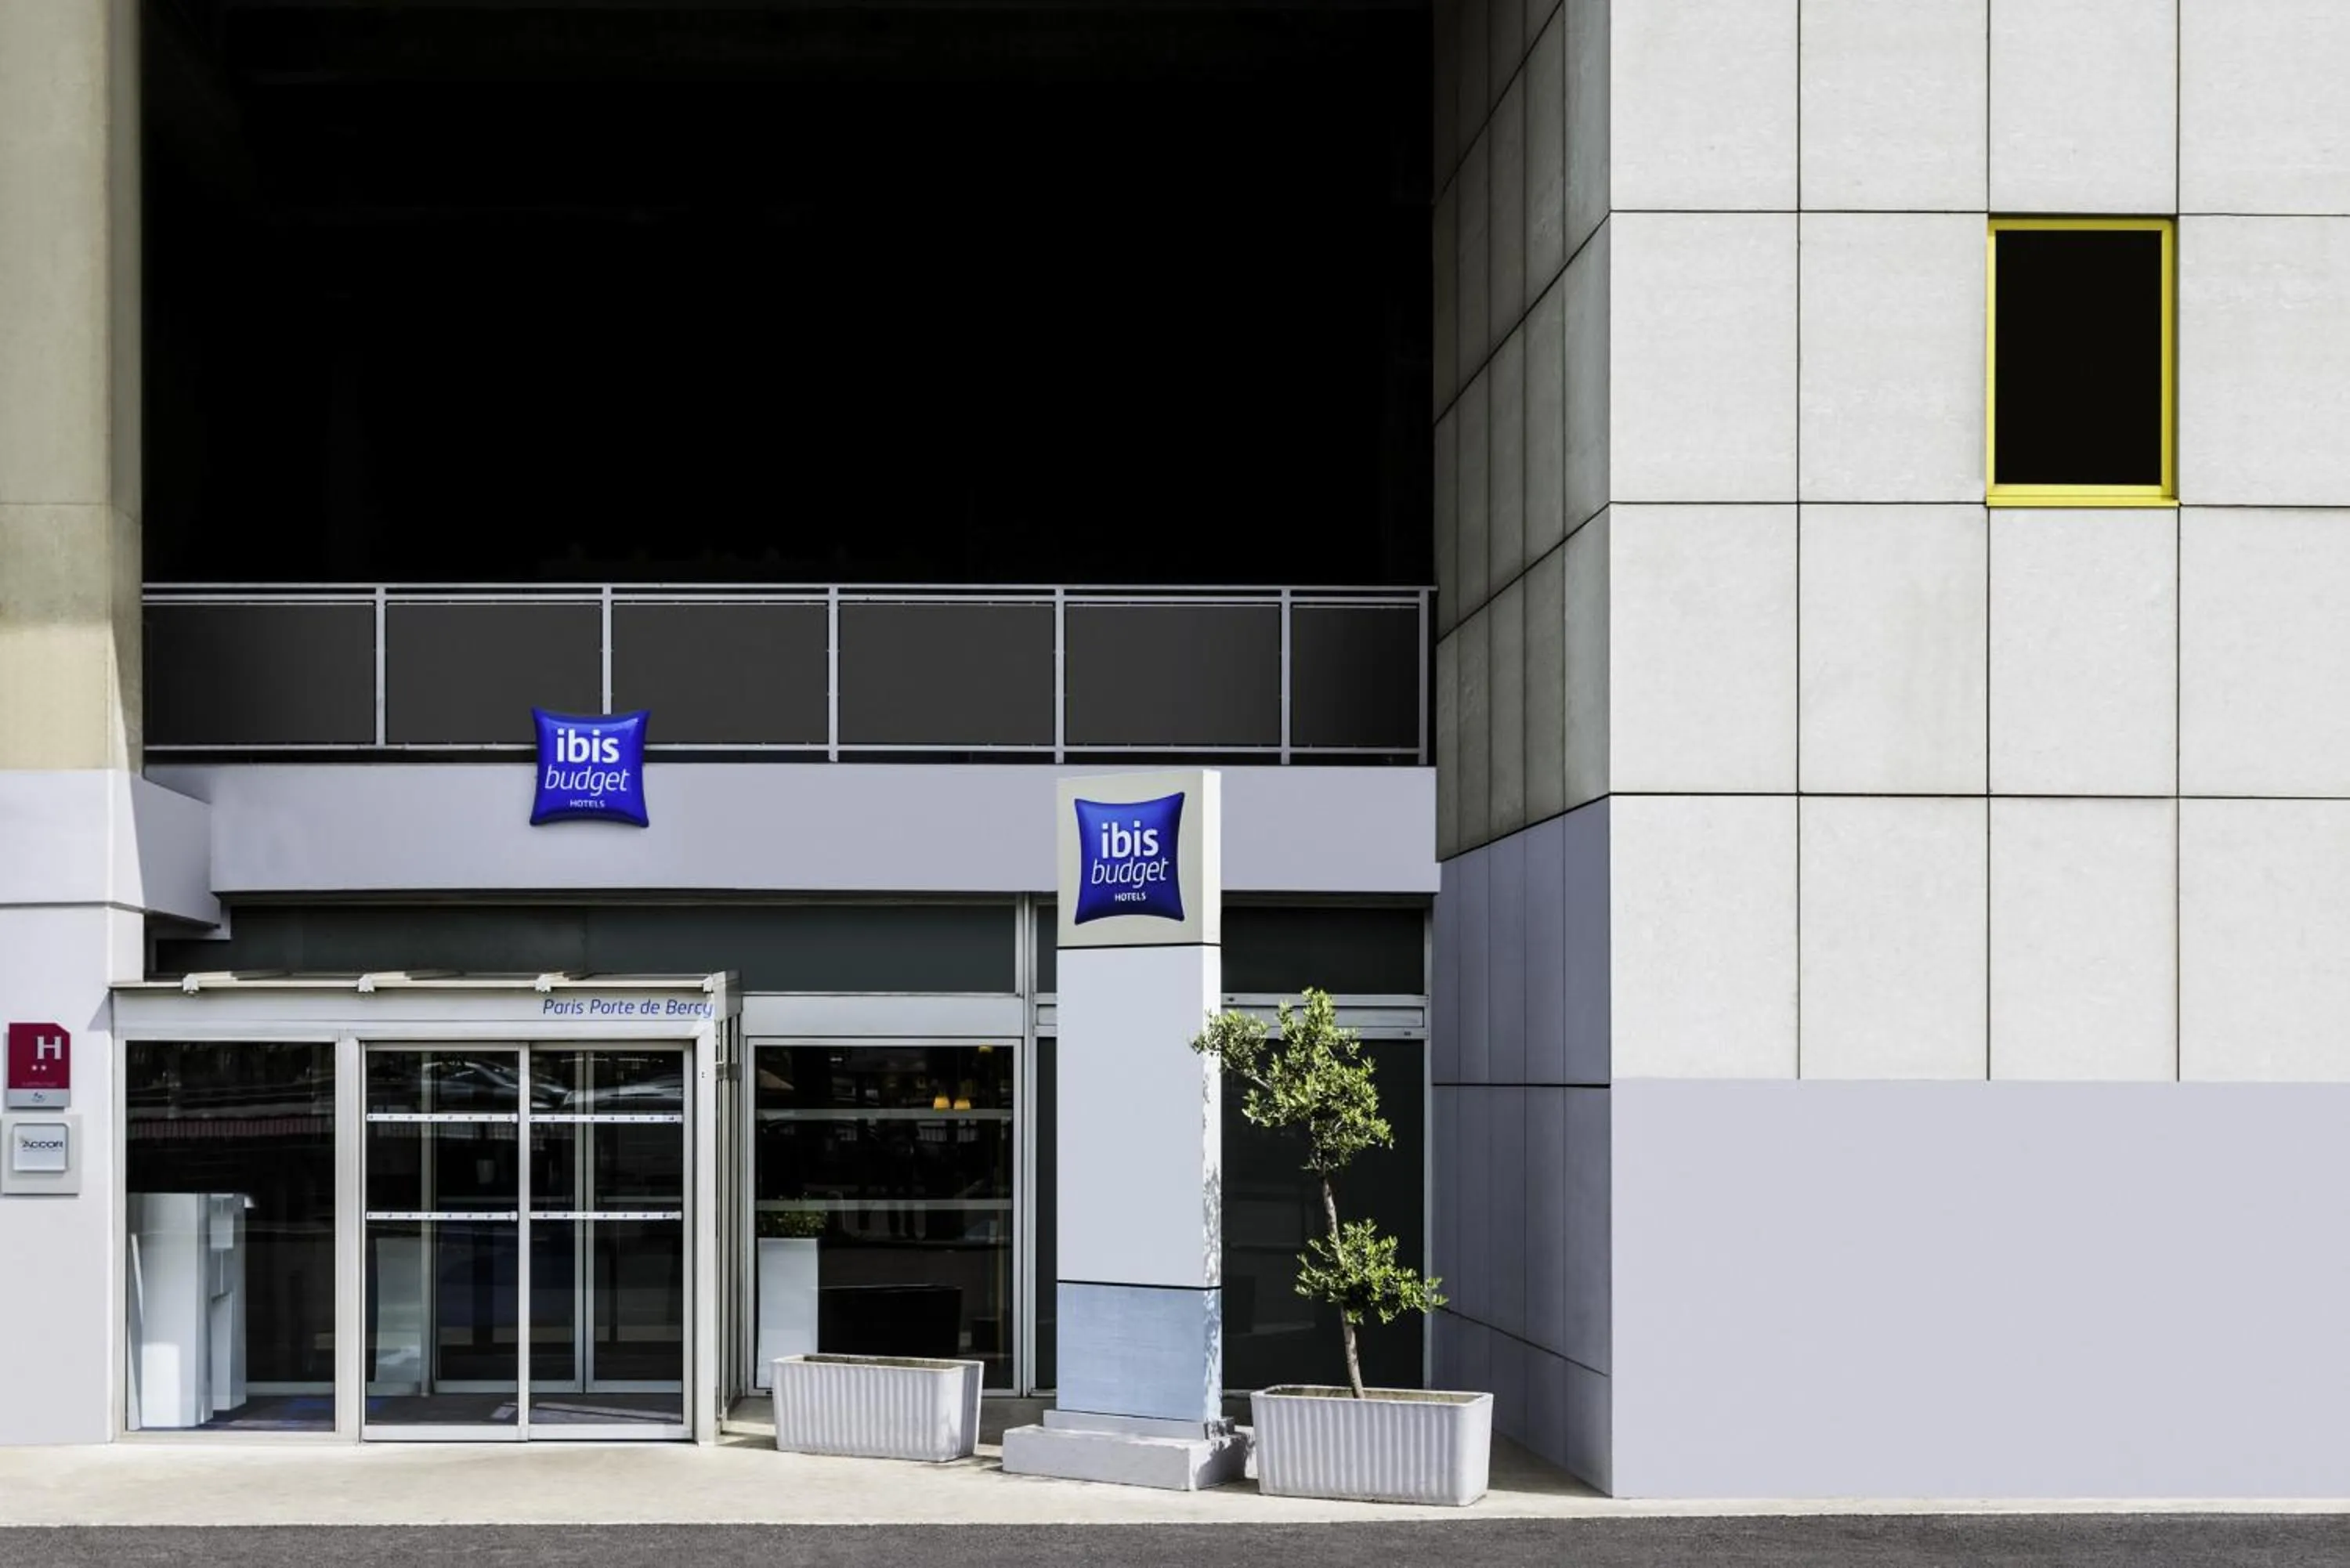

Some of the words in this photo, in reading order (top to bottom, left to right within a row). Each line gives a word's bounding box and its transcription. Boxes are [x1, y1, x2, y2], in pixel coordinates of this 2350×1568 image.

[557, 728, 620, 764] ibis
[544, 764, 631, 797] budget
[569, 799, 606, 808] HOTELS
[1101, 820, 1159, 859] ibis
[1091, 856, 1170, 889] budget
[1115, 891, 1147, 901] HOTELS
[542, 998, 584, 1015] Paris
[589, 998, 635, 1015] Porte
[639, 999, 661, 1015] de
[665, 999, 714, 1018] Bercy
[37, 1035, 62, 1060] H
